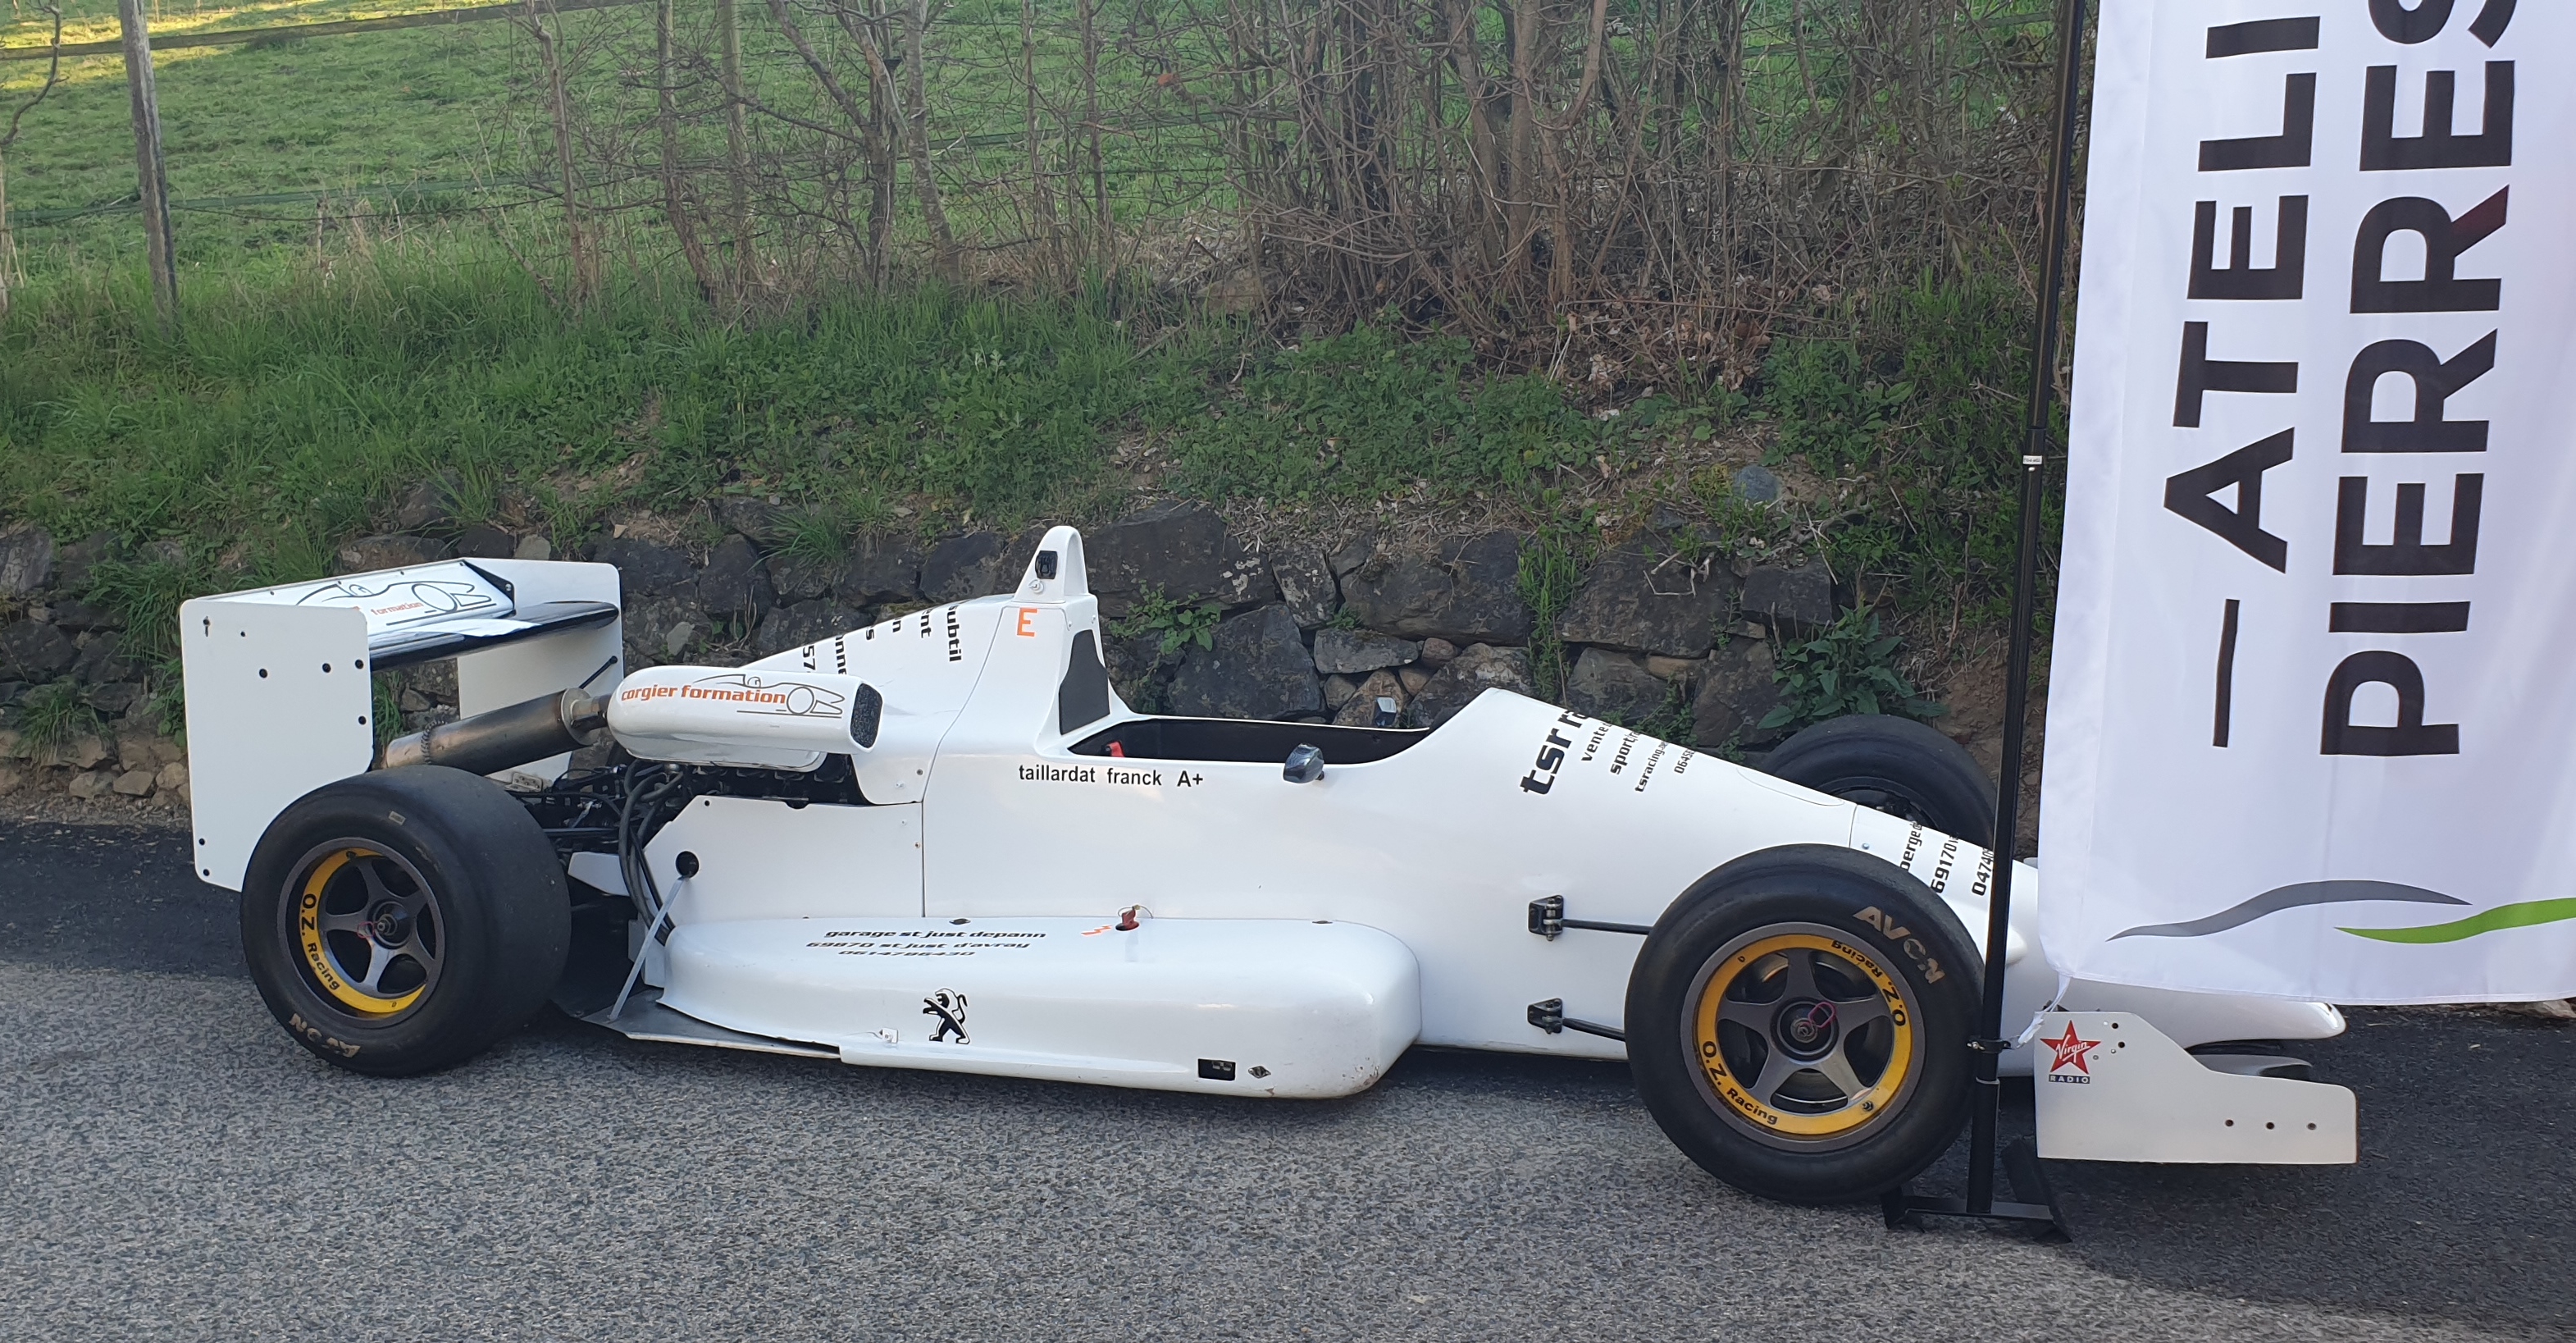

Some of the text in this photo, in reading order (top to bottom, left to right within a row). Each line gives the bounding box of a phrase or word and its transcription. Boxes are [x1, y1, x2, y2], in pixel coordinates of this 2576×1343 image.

[2163, 16, 2320, 573] ATELI
[1017, 607, 1038, 637] E
[621, 684, 786, 704] corgier formation
[1019, 764, 1204, 788] taillardat franck A+
[1520, 728, 1572, 795] tsr
[823, 930, 896, 939] garage
[920, 930, 967, 939] just
[969, 930, 1046, 939] depann
[308, 942, 340, 991] Racing
[1831, 940, 1883, 978] Racing
[2054, 1034, 2091, 1063] Virgin
[2049, 1075, 2089, 1084] RADIO
[1726, 1087, 1779, 1126] Racing
